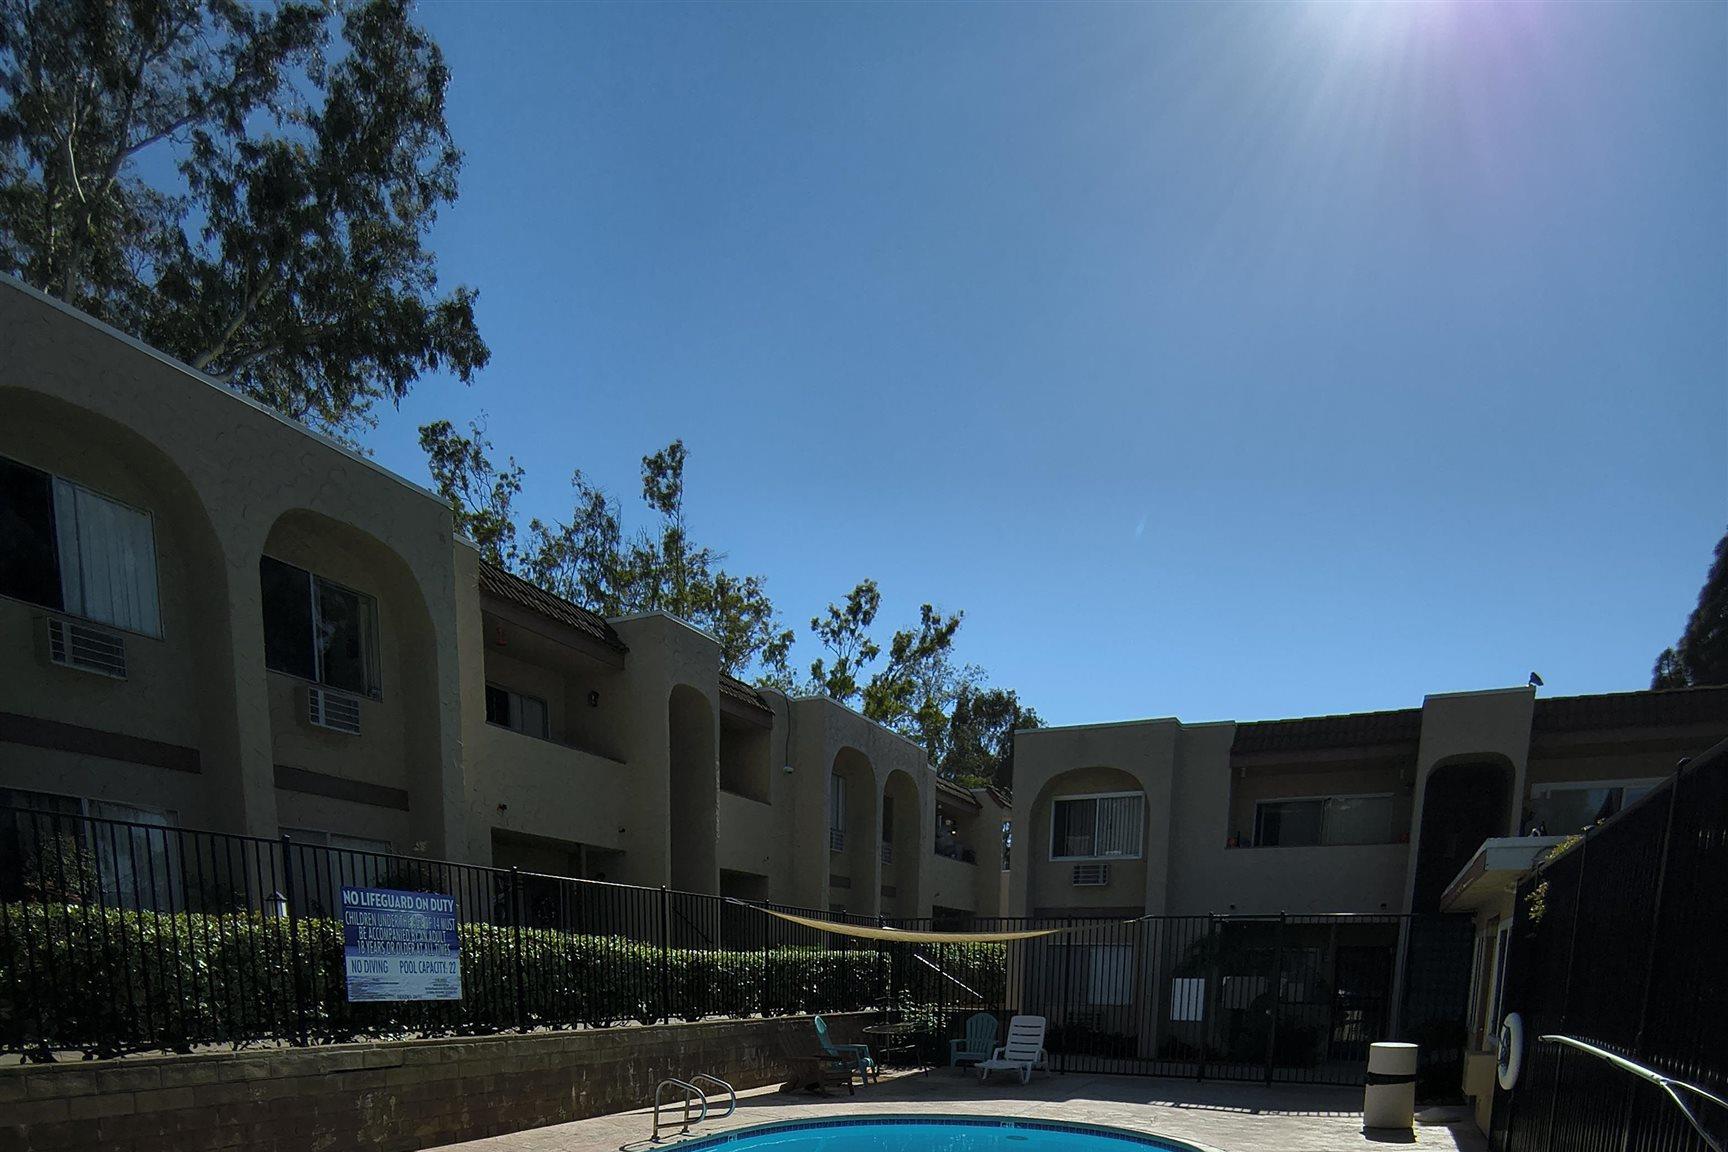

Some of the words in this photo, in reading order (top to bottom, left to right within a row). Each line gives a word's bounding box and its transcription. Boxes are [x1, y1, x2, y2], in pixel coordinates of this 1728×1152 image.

[343, 890, 358, 905] NO
[361, 892, 413, 908] LIFEGUARD
[416, 897, 428, 910] ON
[431, 899, 454, 912] DUTY
[346, 911, 376, 926] CHILDREN
[441, 918, 455, 931] MUST
[359, 926, 367, 940] BE
[368, 927, 410, 942] ACCOMPANIED
[429, 930, 446, 943] ADULT
[358, 940, 365, 954] 18
[366, 940, 385, 954] YEARS
[386, 941, 396, 954] OR
[396, 942, 414, 955] OLDER
[416, 942, 423, 955] AT
[424, 943, 434, 955] ALL
[435, 944, 450, 956] TIMES
[352, 960, 362, 973] NO
[365, 960, 388, 974] DIVING
[400, 960, 417, 974] POOL
[449, 961, 456, 974] 22
